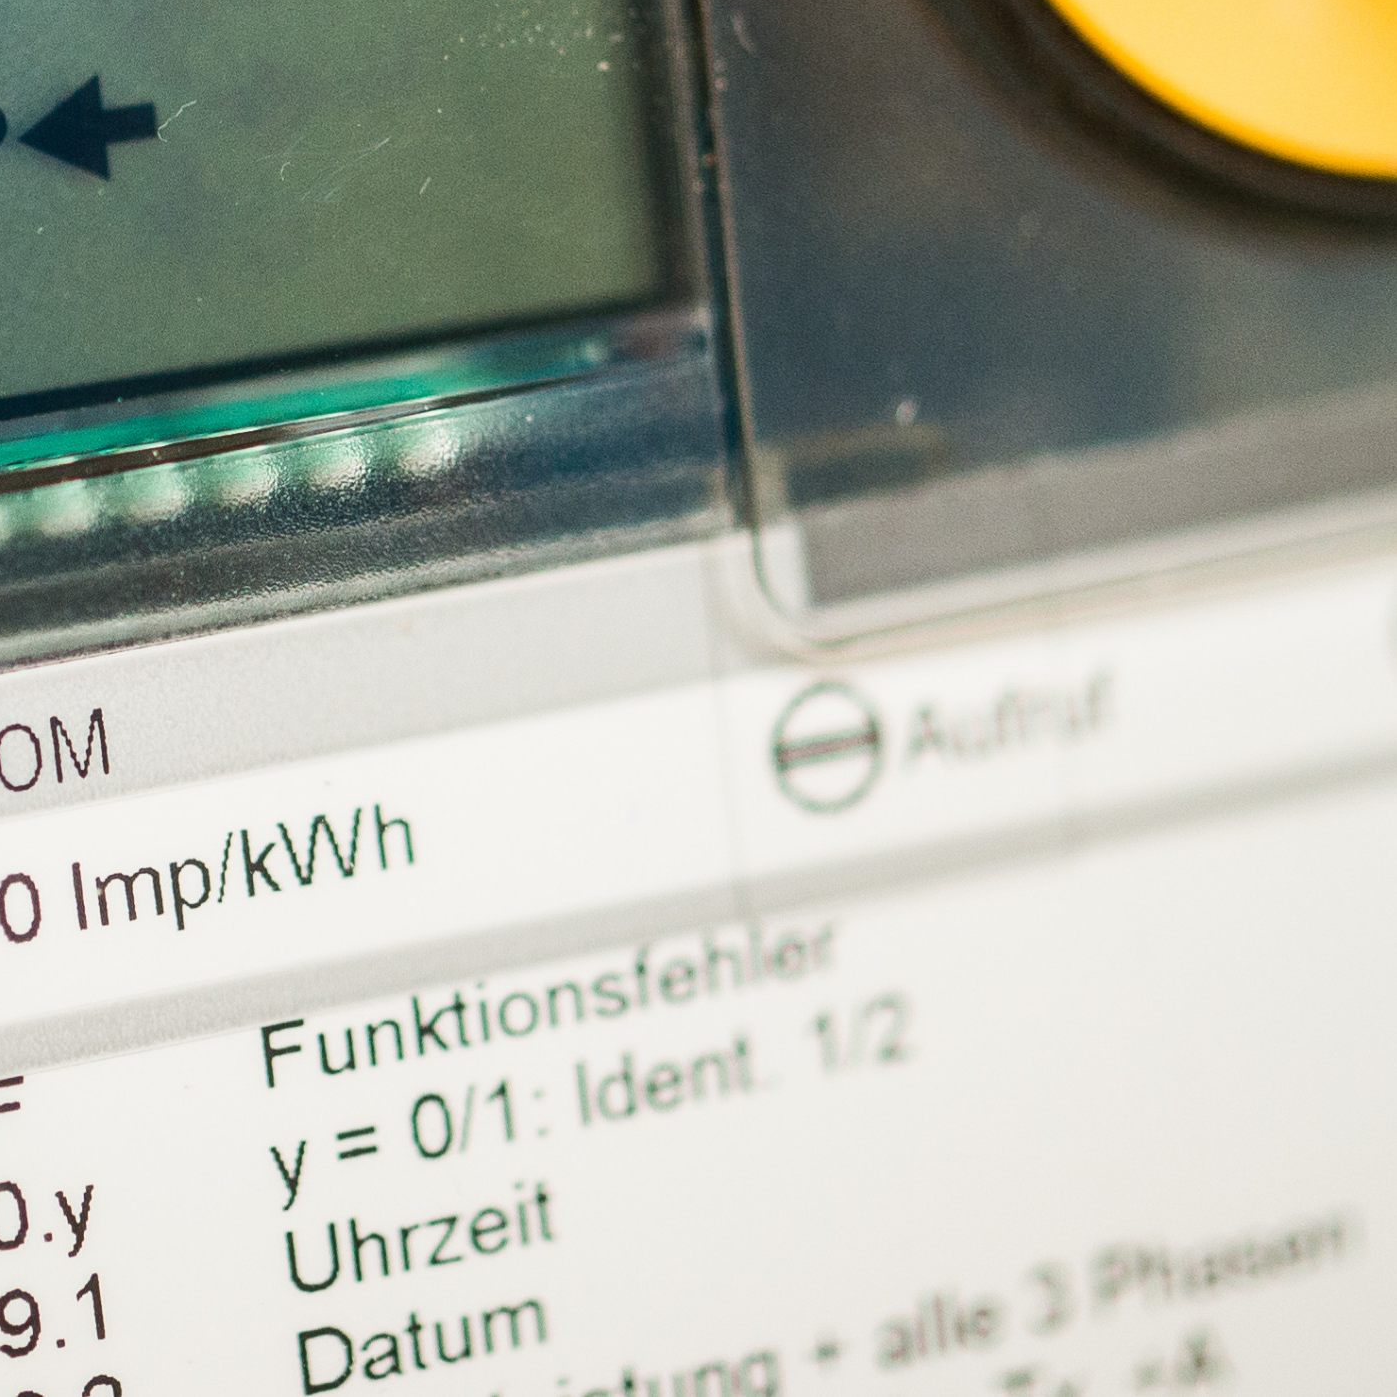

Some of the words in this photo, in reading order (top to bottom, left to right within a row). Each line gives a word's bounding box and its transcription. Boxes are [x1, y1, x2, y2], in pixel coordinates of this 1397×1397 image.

[71, 804, 416, 930] Imp/kWh
[261, 920, 838, 1089] Funktionsfehler
[271, 1139, 306, 1211] y
[409, 1080, 551, 1160] 0/1:
[285, 1180, 554, 1293] Uhrzeit
[298, 1299, 547, 1396] Datum
